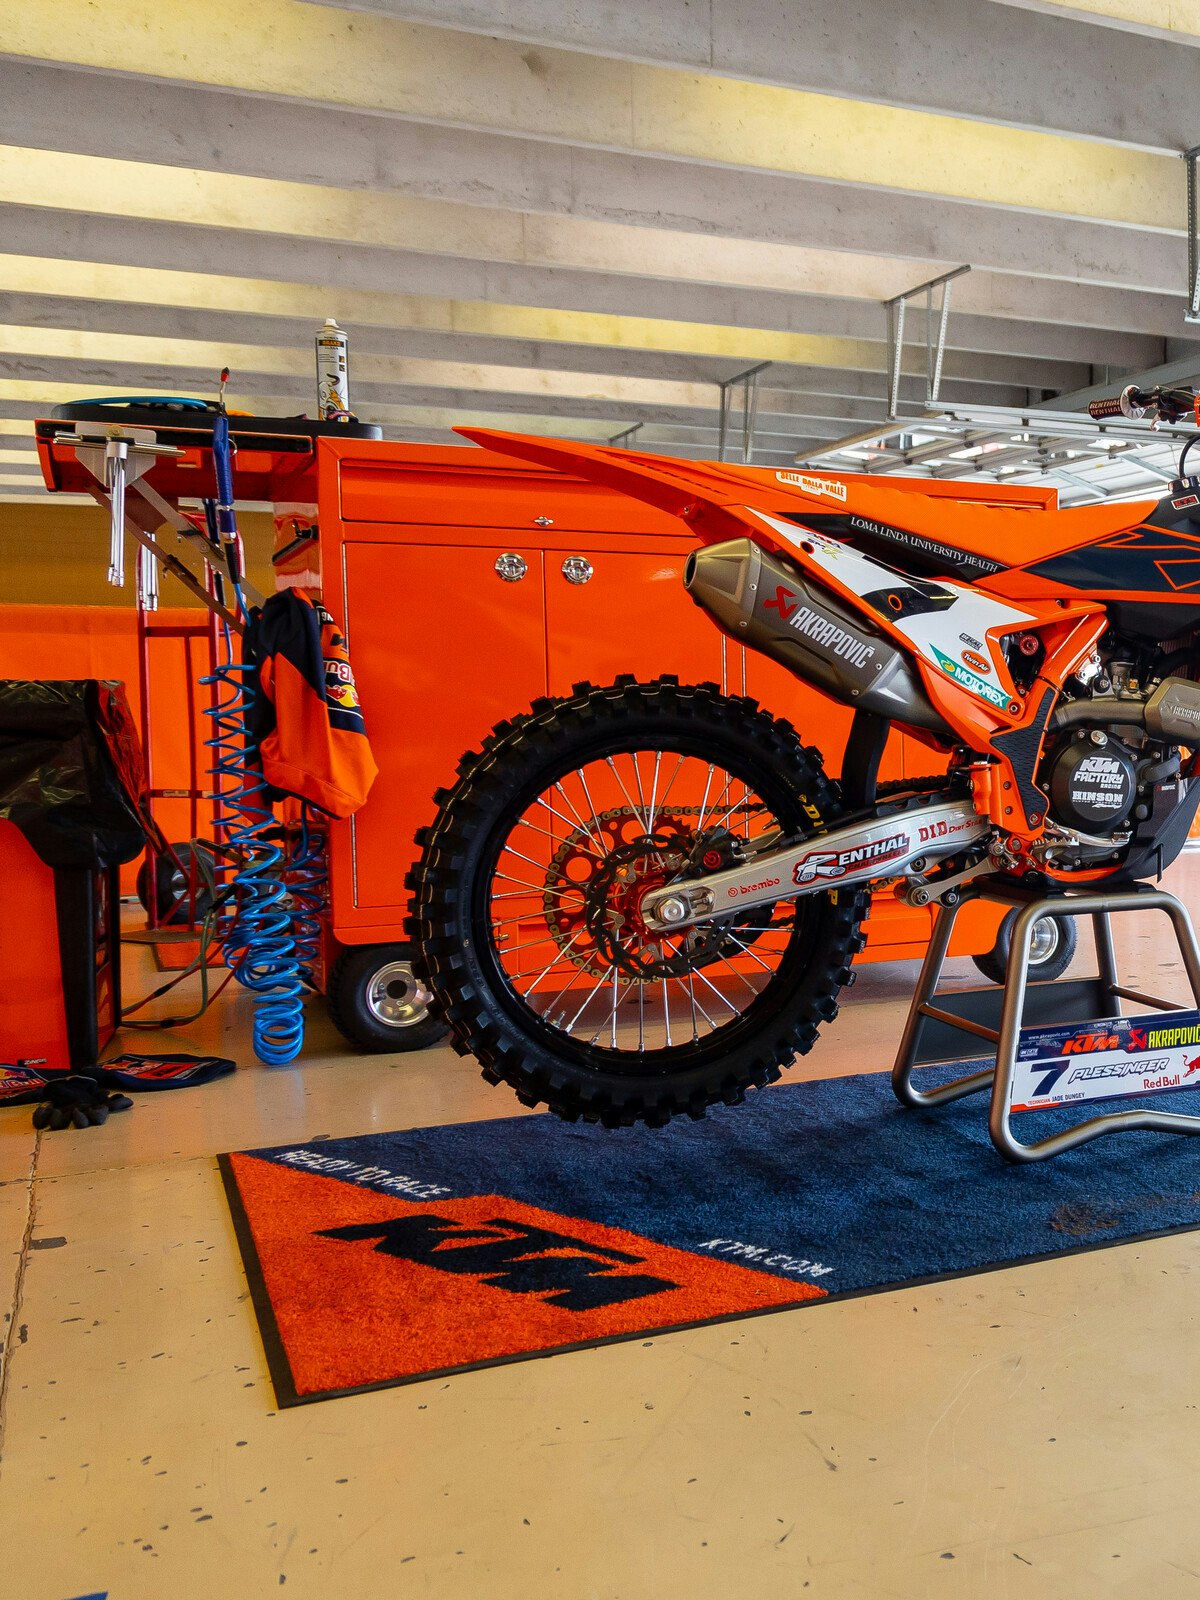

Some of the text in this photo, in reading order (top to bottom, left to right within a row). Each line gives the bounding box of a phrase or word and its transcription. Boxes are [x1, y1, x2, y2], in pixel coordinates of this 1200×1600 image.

[780, 471, 845, 498] SELLE DALLA VALLE
[850, 516, 999, 573] LOMA LINDA UNIVERSITY HEALTH
[954, 666, 1006, 707] MOTOREX
[1079, 756, 1120, 773] KTM
[1073, 771, 1124, 785] FACTORY
[1072, 791, 1123, 802] HINSON
[740, 877, 781, 895] brembo
[1061, 1031, 1120, 1055] KTM
[1030, 1059, 1071, 1097] 7
[1068, 1058, 1170, 1084] PLESSINGER
[1143, 1074, 1181, 1089] Red Bull
[374, 1174, 453, 1199] RACE
[311, 1214, 683, 1313] KTM
[698, 1238, 836, 1278] KTM.COM
